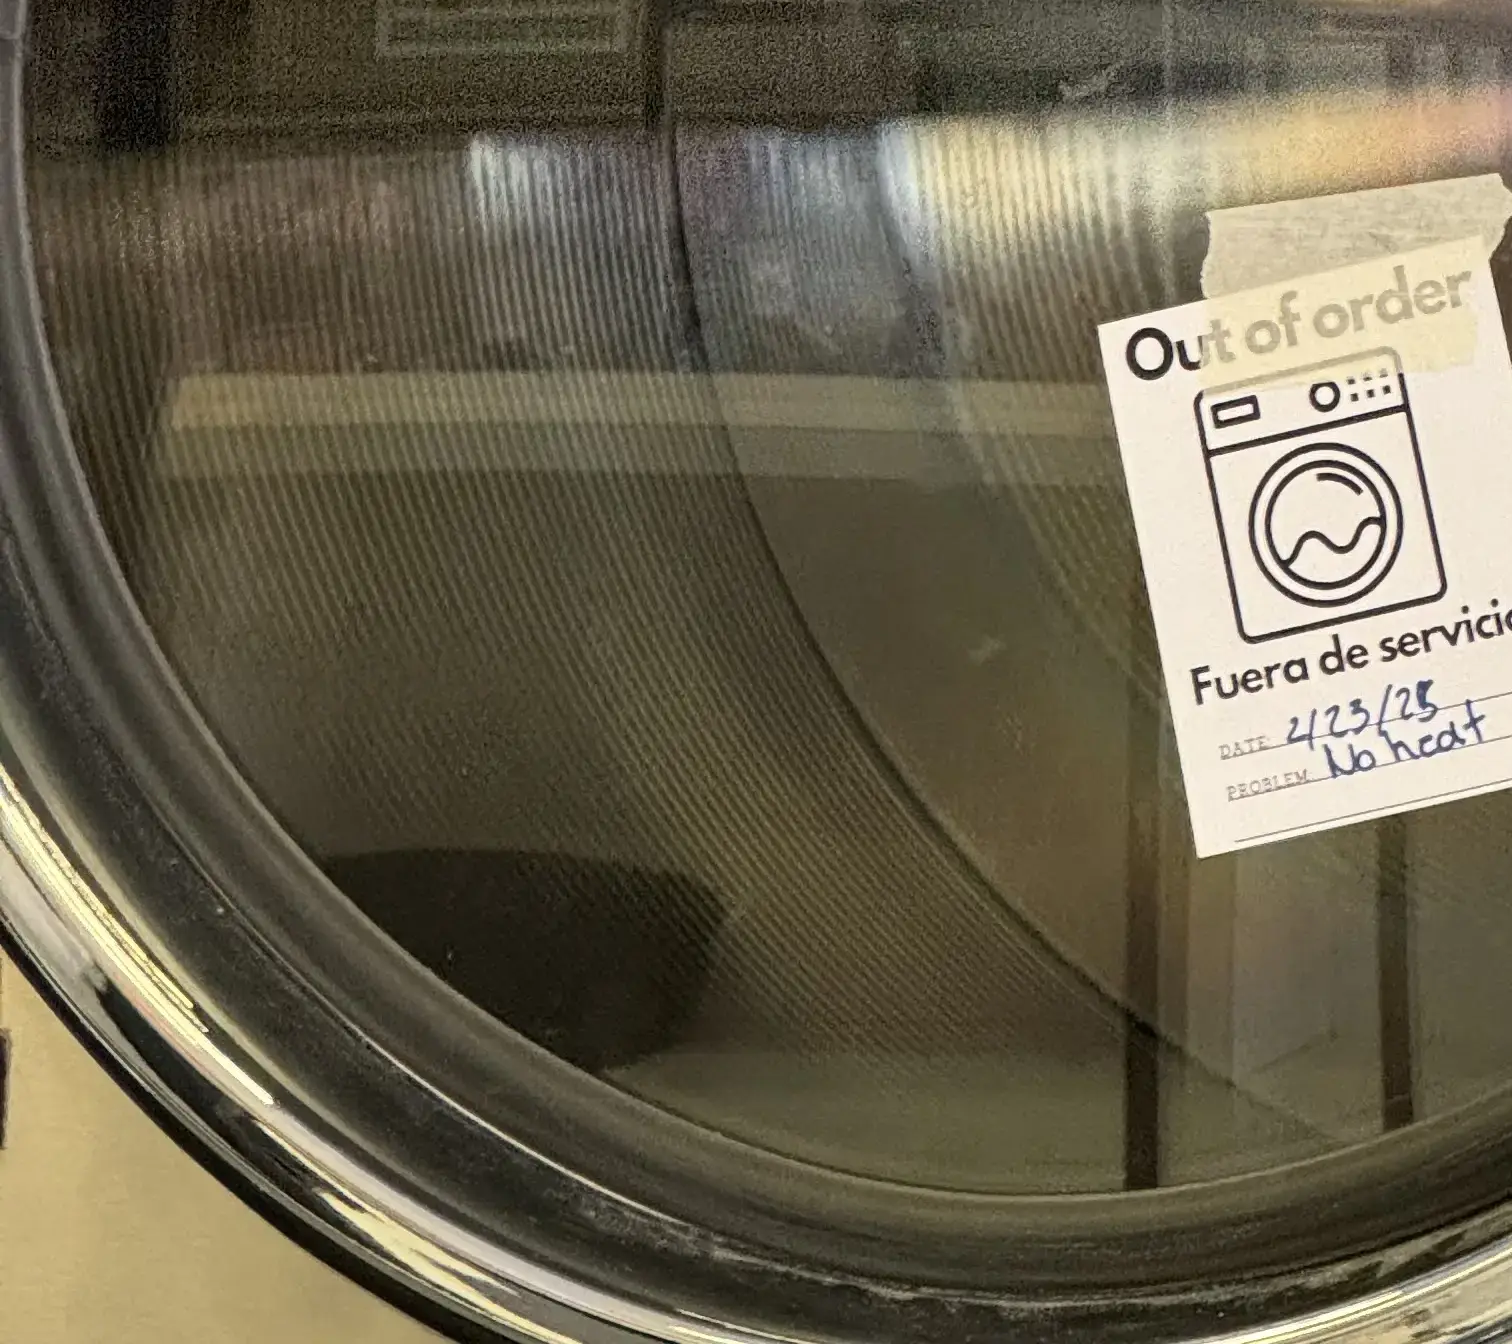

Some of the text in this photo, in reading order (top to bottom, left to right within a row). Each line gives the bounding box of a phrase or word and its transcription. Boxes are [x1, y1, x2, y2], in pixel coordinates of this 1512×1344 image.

[1124, 264, 1473, 381] Out of order
[1189, 657, 1310, 706] Fuera
[1318, 633, 1370, 676] de
[1322, 699, 1486, 779] No heat
